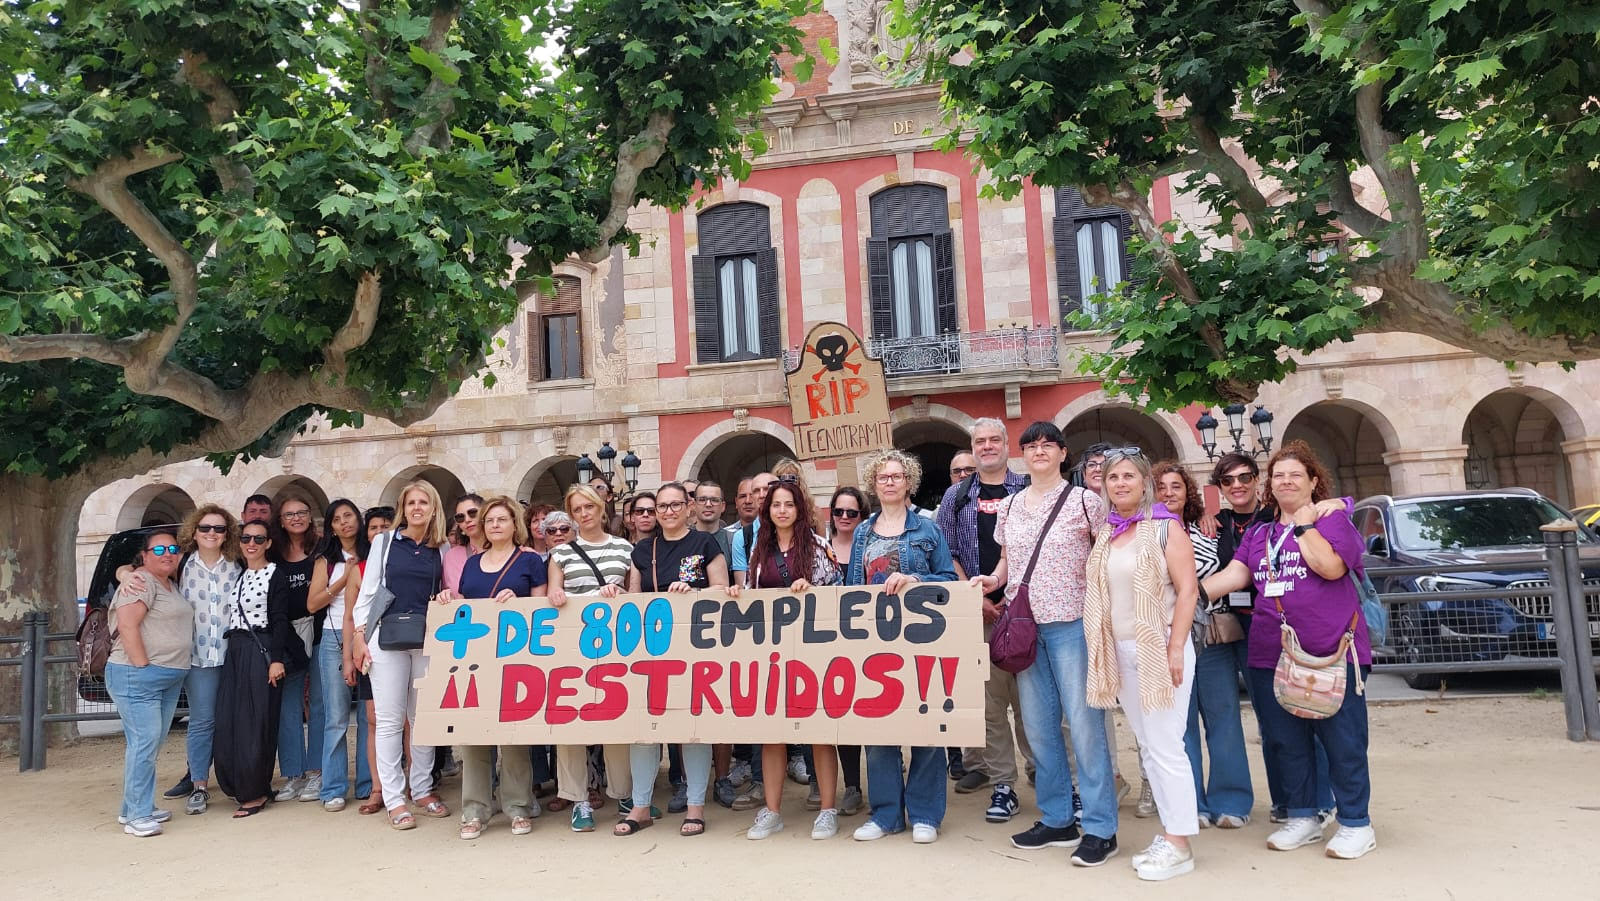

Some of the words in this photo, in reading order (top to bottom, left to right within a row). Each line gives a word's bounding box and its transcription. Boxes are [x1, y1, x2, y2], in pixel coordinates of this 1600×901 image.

[893, 119, 914, 135] DE
[495, 607, 560, 659] DE
[578, 596, 674, 660] 800
[689, 584, 951, 649] EMPLEOS
